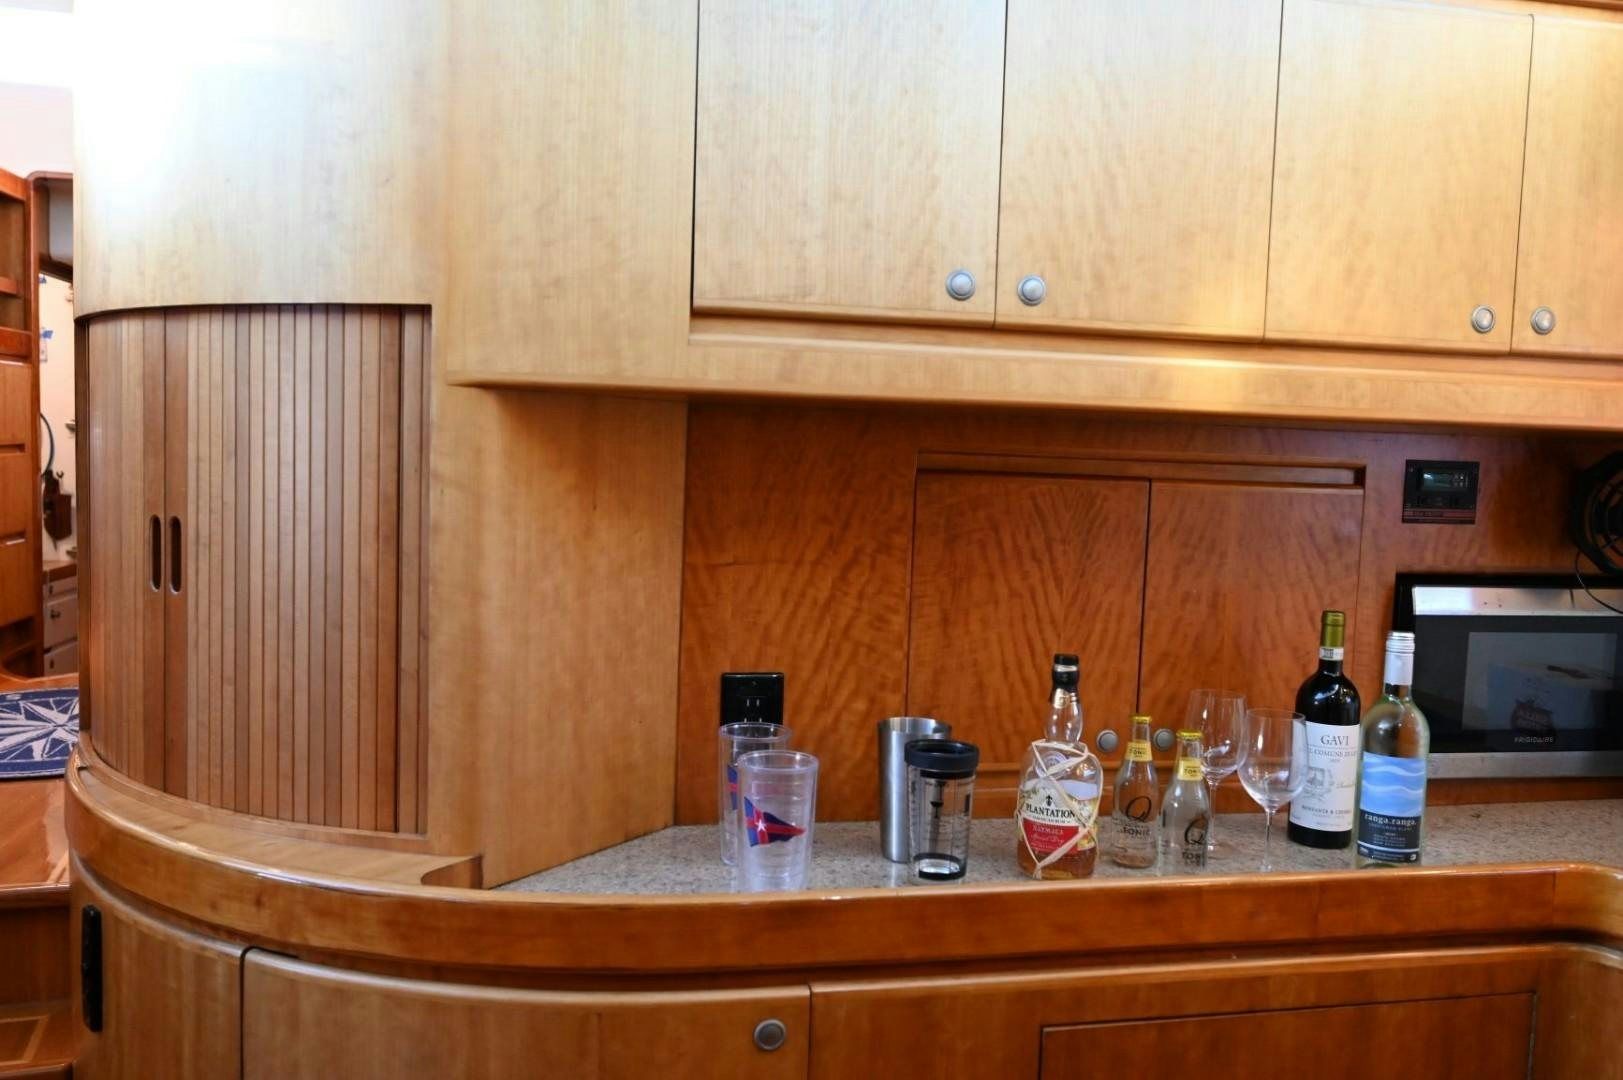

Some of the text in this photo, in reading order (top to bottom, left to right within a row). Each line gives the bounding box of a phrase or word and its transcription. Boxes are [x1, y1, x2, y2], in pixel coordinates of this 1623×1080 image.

[1320, 735, 1349, 746] GAVI
[1026, 803, 1076, 819] PLANTATION
[1126, 796, 1152, 823] Q
[1123, 826, 1151, 836] TONIC
[1184, 817, 1208, 846] Q
